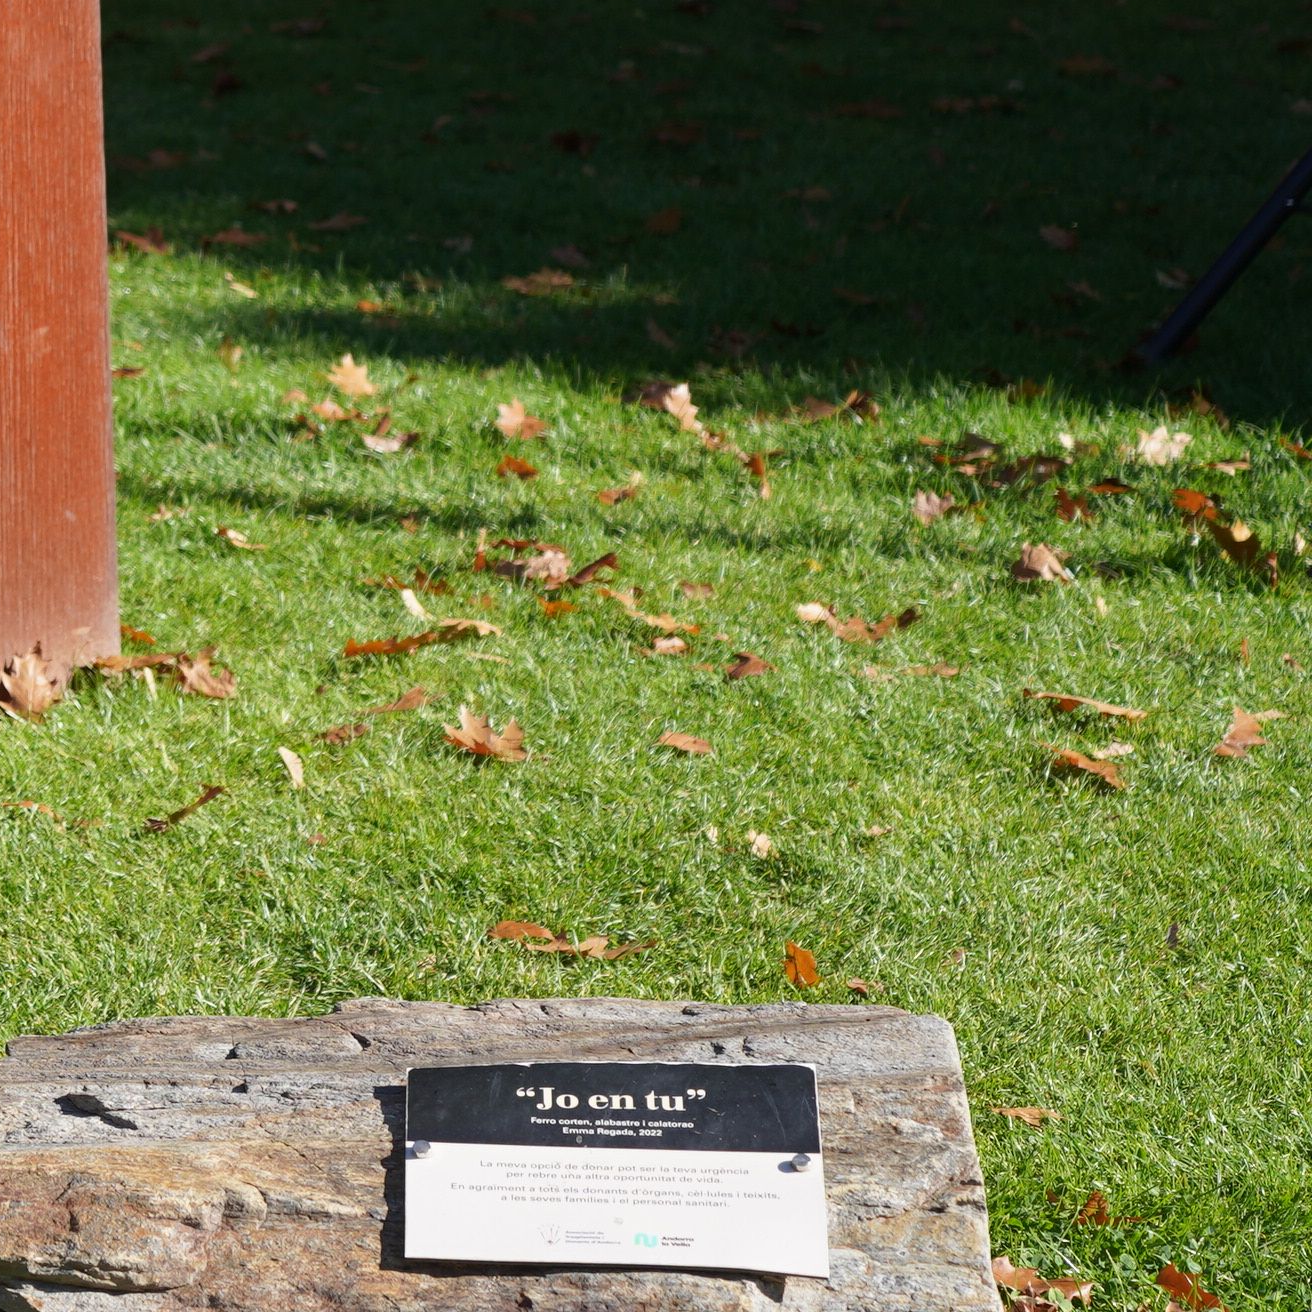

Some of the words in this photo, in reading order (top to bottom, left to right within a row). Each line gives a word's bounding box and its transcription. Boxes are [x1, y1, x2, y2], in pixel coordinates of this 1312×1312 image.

[587, 1094, 637, 1110] en
[530, 1116, 557, 1125] Ferro
[558, 1118, 593, 1127] corten,
[595, 1118, 640, 1127] alabastre
[647, 1120, 694, 1129] calatorao
[562, 1127, 594, 1135] Emma
[597, 1127, 637, 1136] Regada,
[638, 1128, 663, 1136] 2022
[480, 1160, 493, 1168] La
[496, 1161, 527, 1169] meva
[581, 1163, 614, 1171] donar
[700, 1167, 749, 1175] urgència
[528, 1171, 558, 1179] rebre
[613, 1174, 676, 1182] oportunitat
[679, 1175, 693, 1183] de
[696, 1176, 723, 1184] vida.
[450, 1182, 465, 1190] En
[582, 1187, 628, 1195] donants
